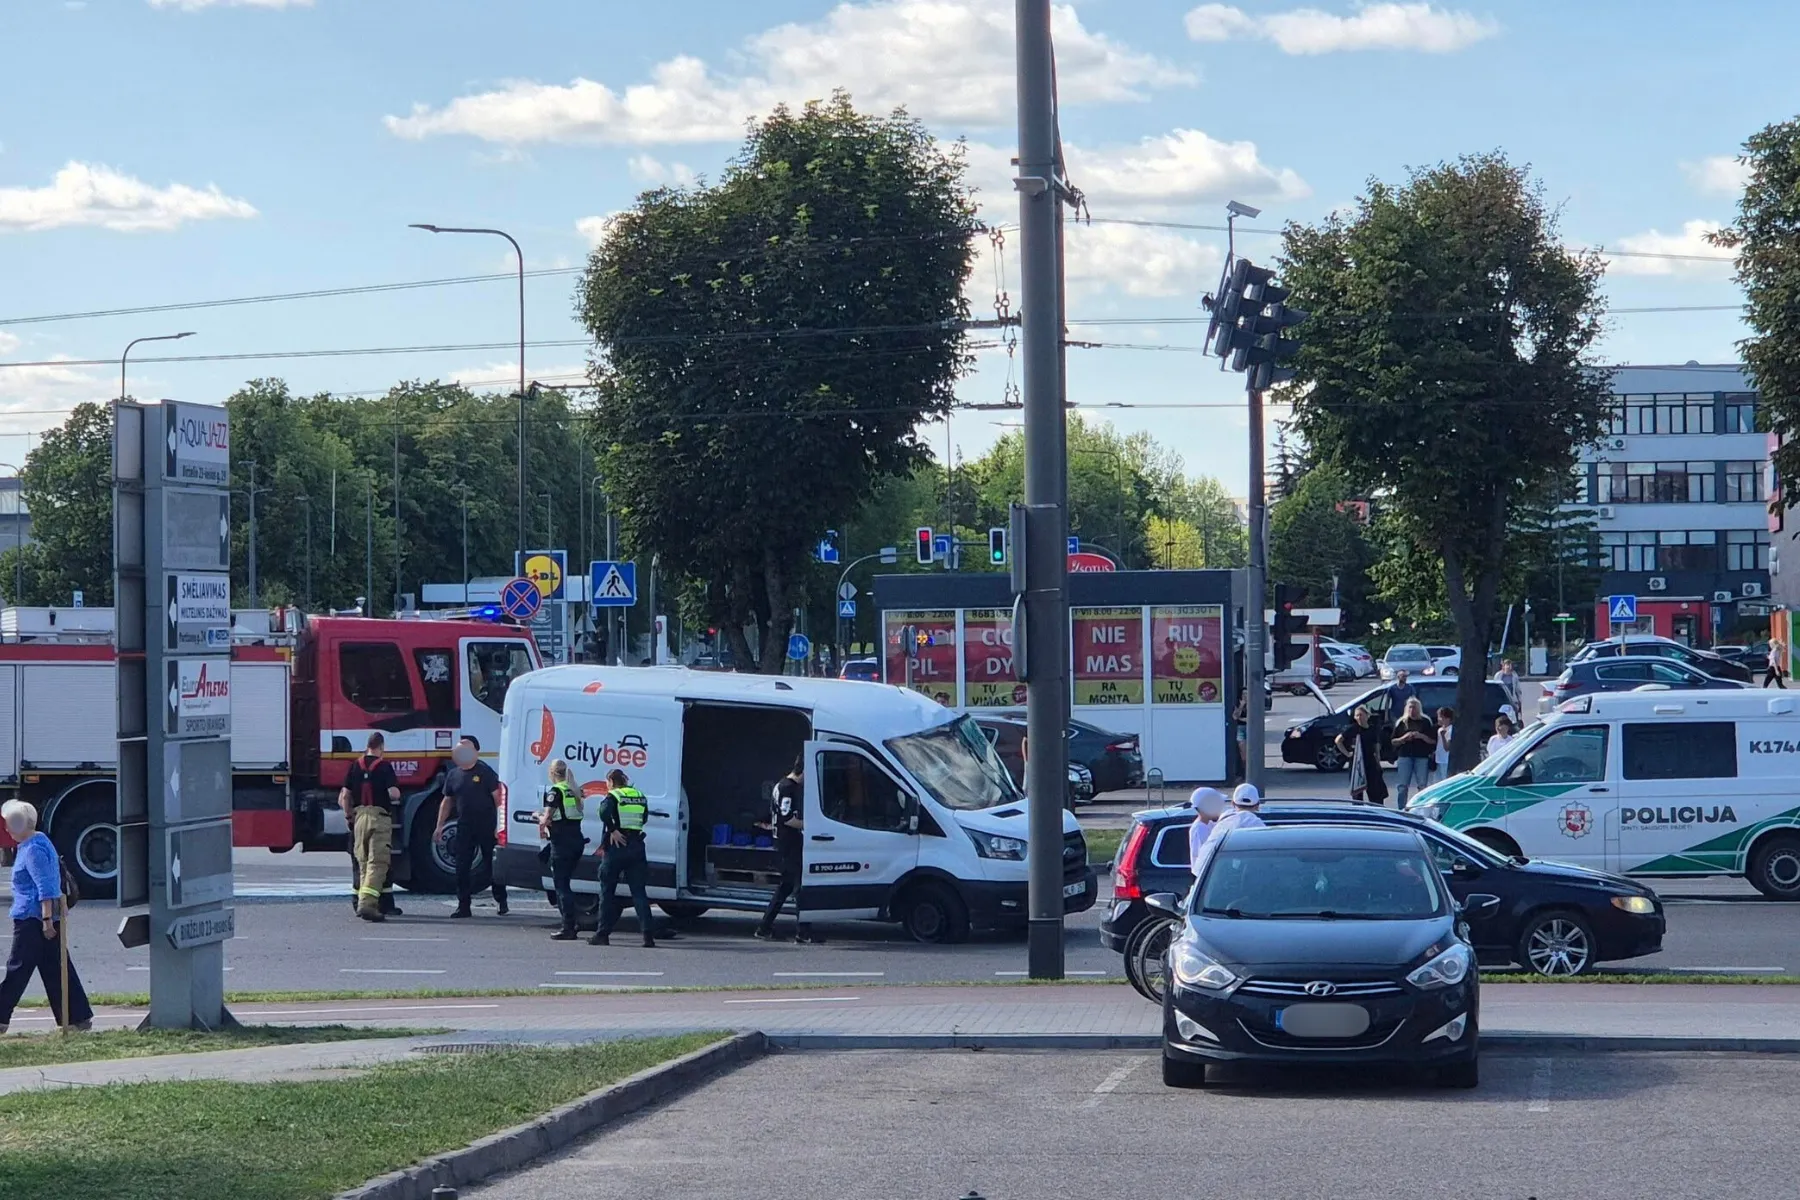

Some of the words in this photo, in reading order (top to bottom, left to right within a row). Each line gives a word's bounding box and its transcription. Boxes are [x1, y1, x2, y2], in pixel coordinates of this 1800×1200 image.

[180, 417, 228, 449] AQUAJAZZ
[182, 578, 227, 600] SMĖLIAVIMAS
[1092, 626, 1126, 643] NIE
[1168, 625, 1203, 647] RIŲ
[1086, 655, 1132, 673] MAS
[1102, 681, 1117, 691] RA
[1168, 681, 1183, 691] TŲ
[972, 696, 1008, 706] VIMAS
[1089, 694, 1130, 704] MONTA
[1158, 693, 1194, 703] VIMAS
[564, 741, 647, 768] citybee
[391, 761, 407, 771] 112
[1621, 805, 1738, 824] POLICIJA
[180, 919, 204, 941] BIRŽELIO
